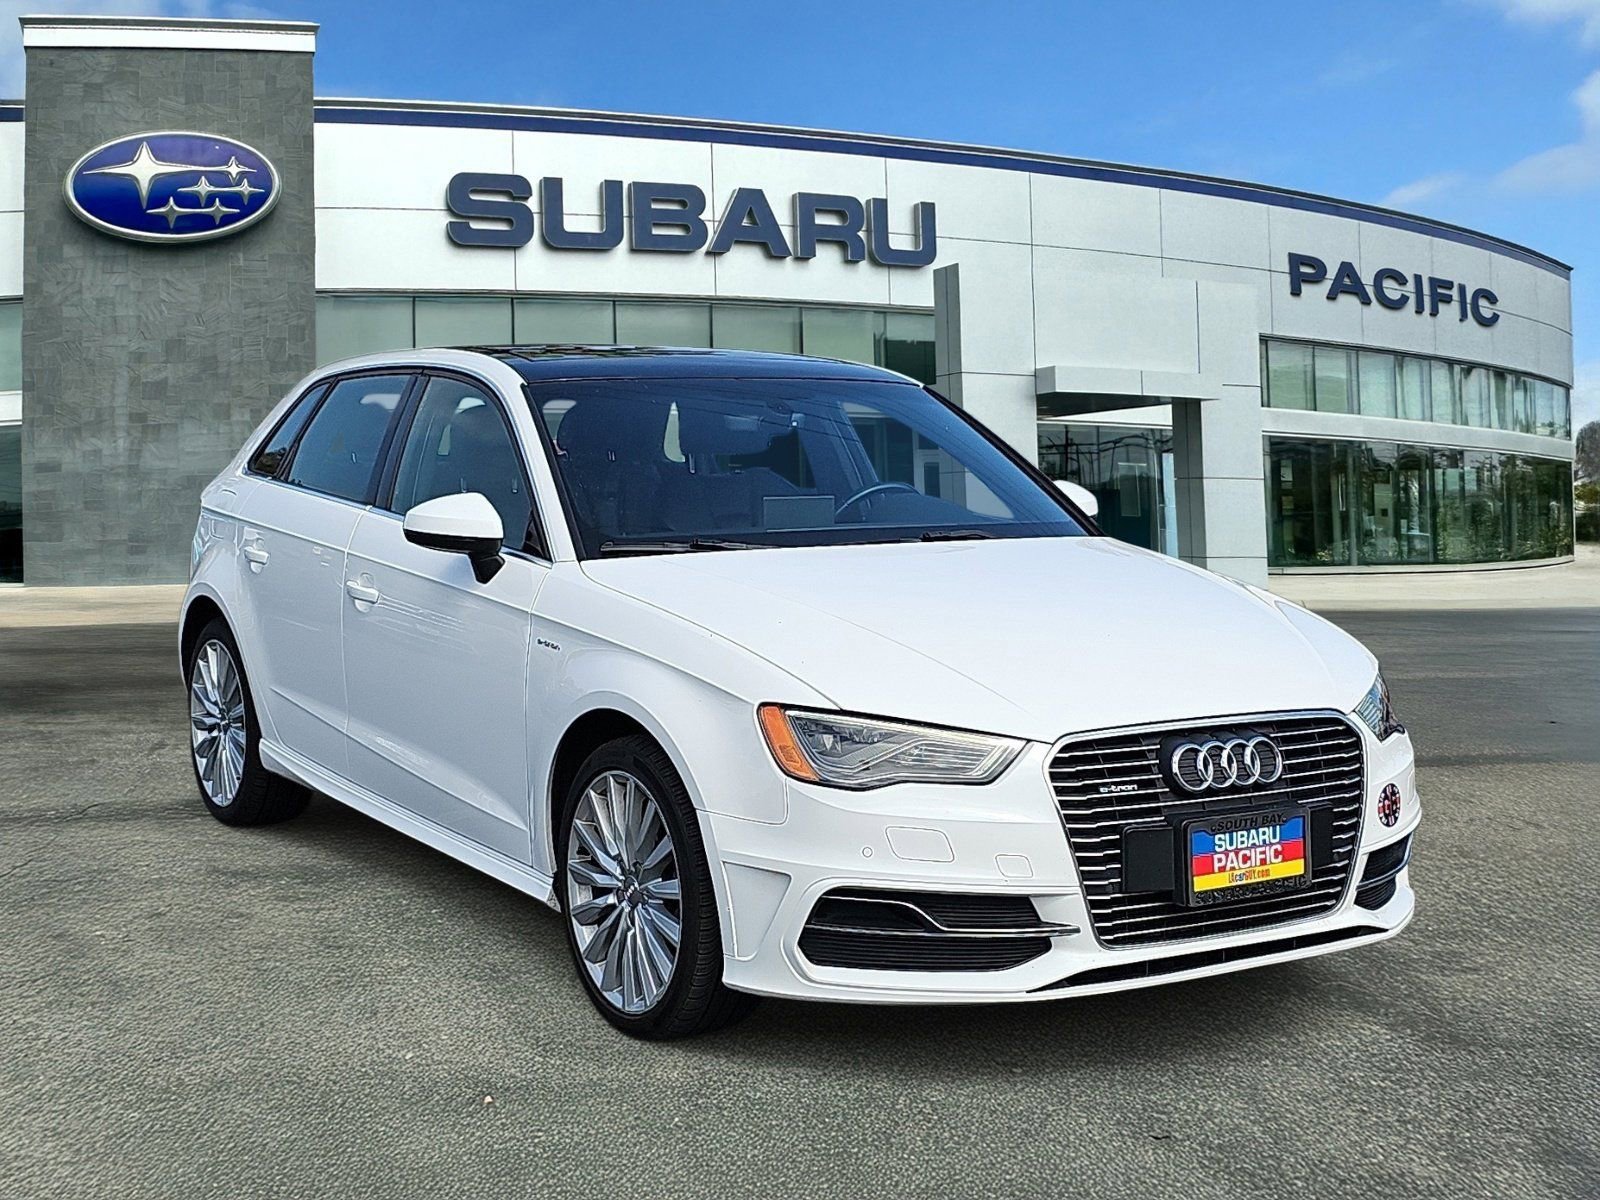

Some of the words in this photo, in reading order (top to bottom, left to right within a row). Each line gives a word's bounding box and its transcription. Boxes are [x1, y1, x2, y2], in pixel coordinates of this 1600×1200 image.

[446, 172, 936, 267] SUBARU
[1288, 252, 1500, 327] PACIFIC
[1217, 817, 1258, 831] SOUTH
[1261, 812, 1284, 825] BAY
[1214, 825, 1280, 852] SUBARU
[1213, 844, 1283, 873] PACIFIC
